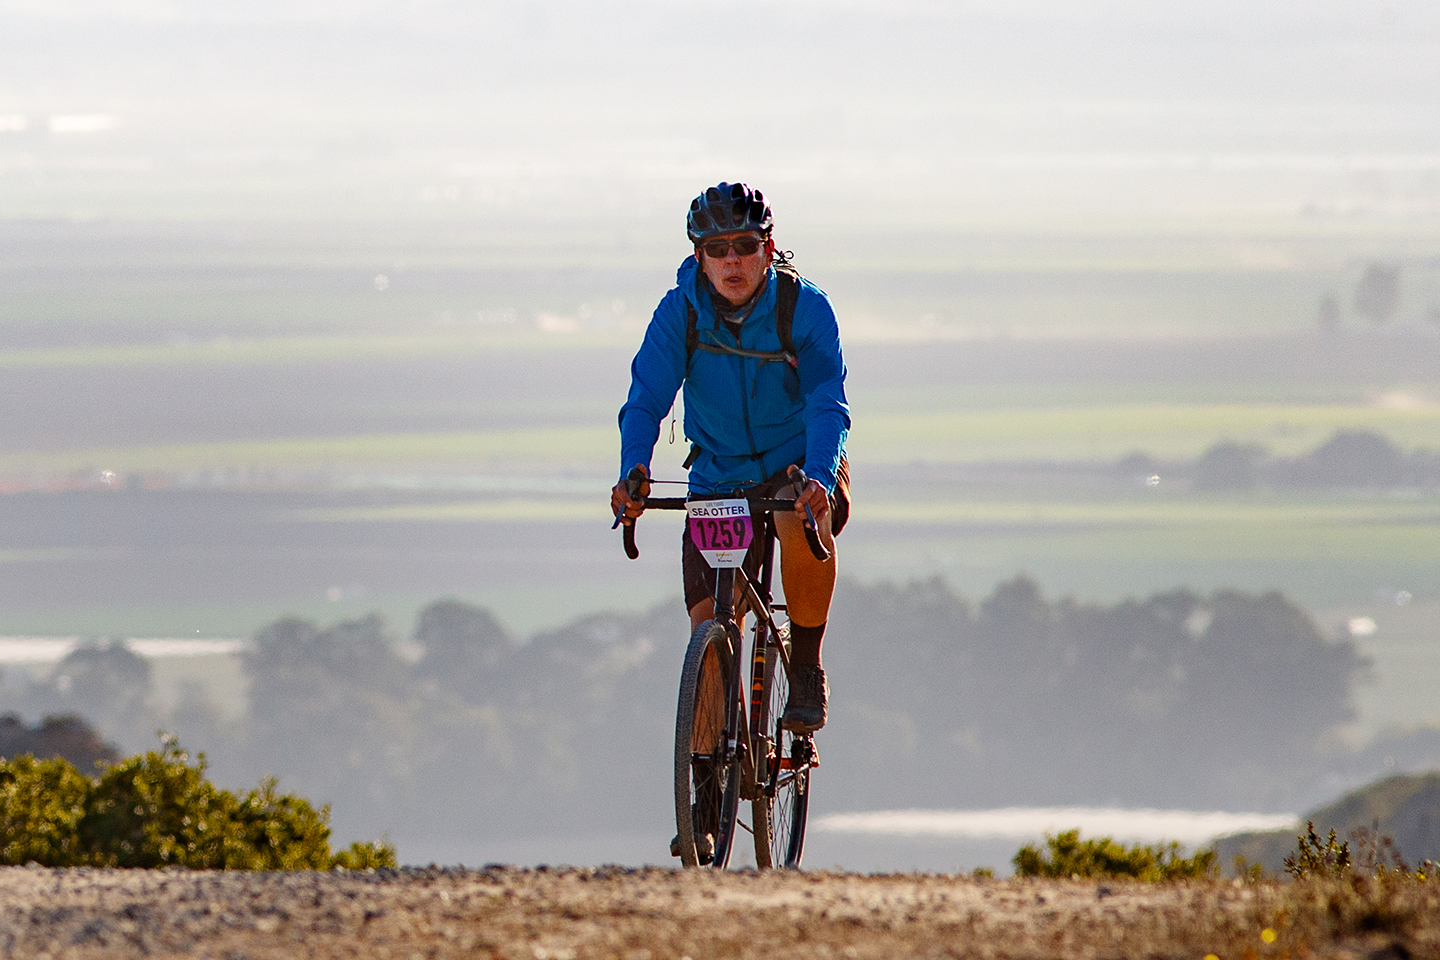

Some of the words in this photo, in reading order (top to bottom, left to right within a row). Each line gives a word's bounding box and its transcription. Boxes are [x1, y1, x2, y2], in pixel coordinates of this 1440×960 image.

[691, 507, 710, 516] SEA
[711, 506, 745, 516] OTTER
[696, 518, 746, 548] 1259
